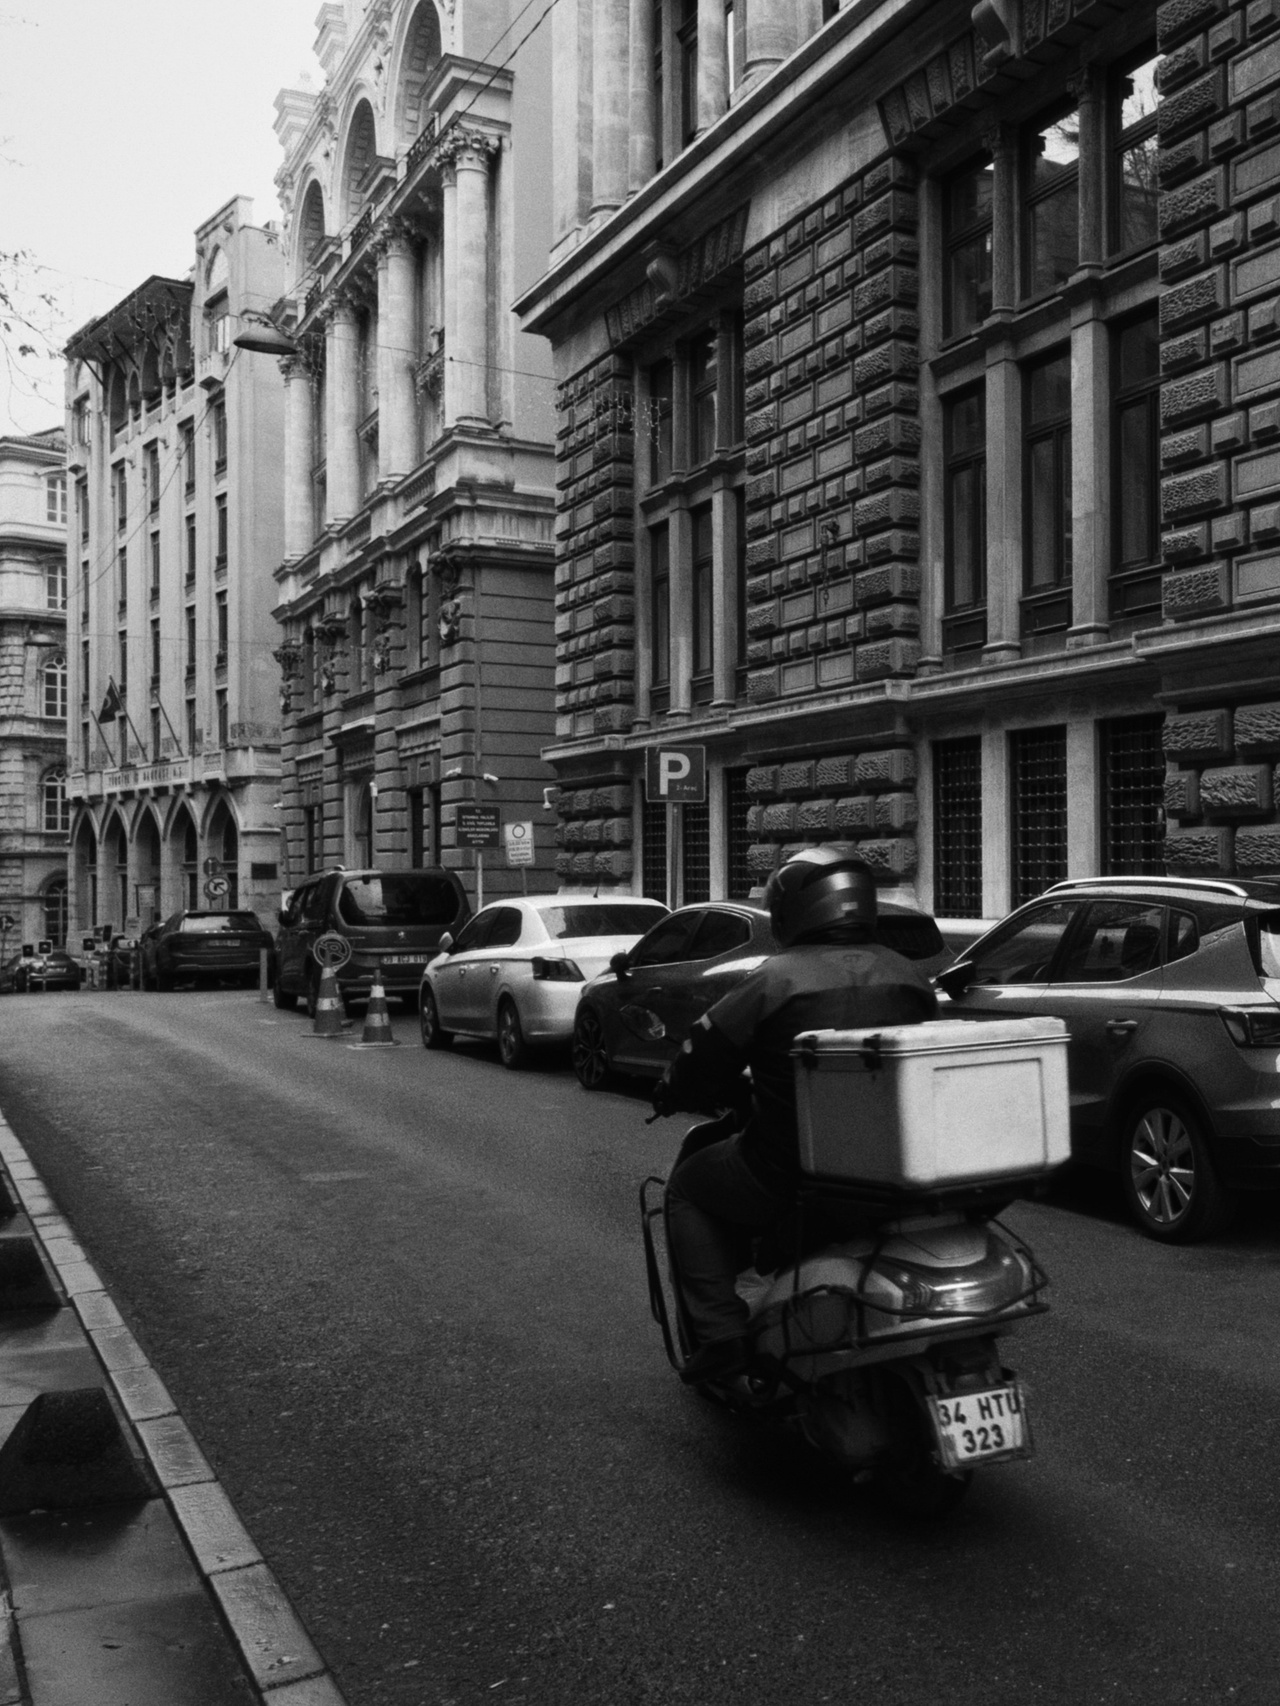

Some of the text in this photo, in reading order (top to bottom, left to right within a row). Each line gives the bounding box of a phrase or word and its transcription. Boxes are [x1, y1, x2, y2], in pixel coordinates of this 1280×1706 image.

[660, 752, 691, 795] P
[939, 1392, 1021, 1426] 34 HTU
[963, 1424, 1004, 1453] 323
